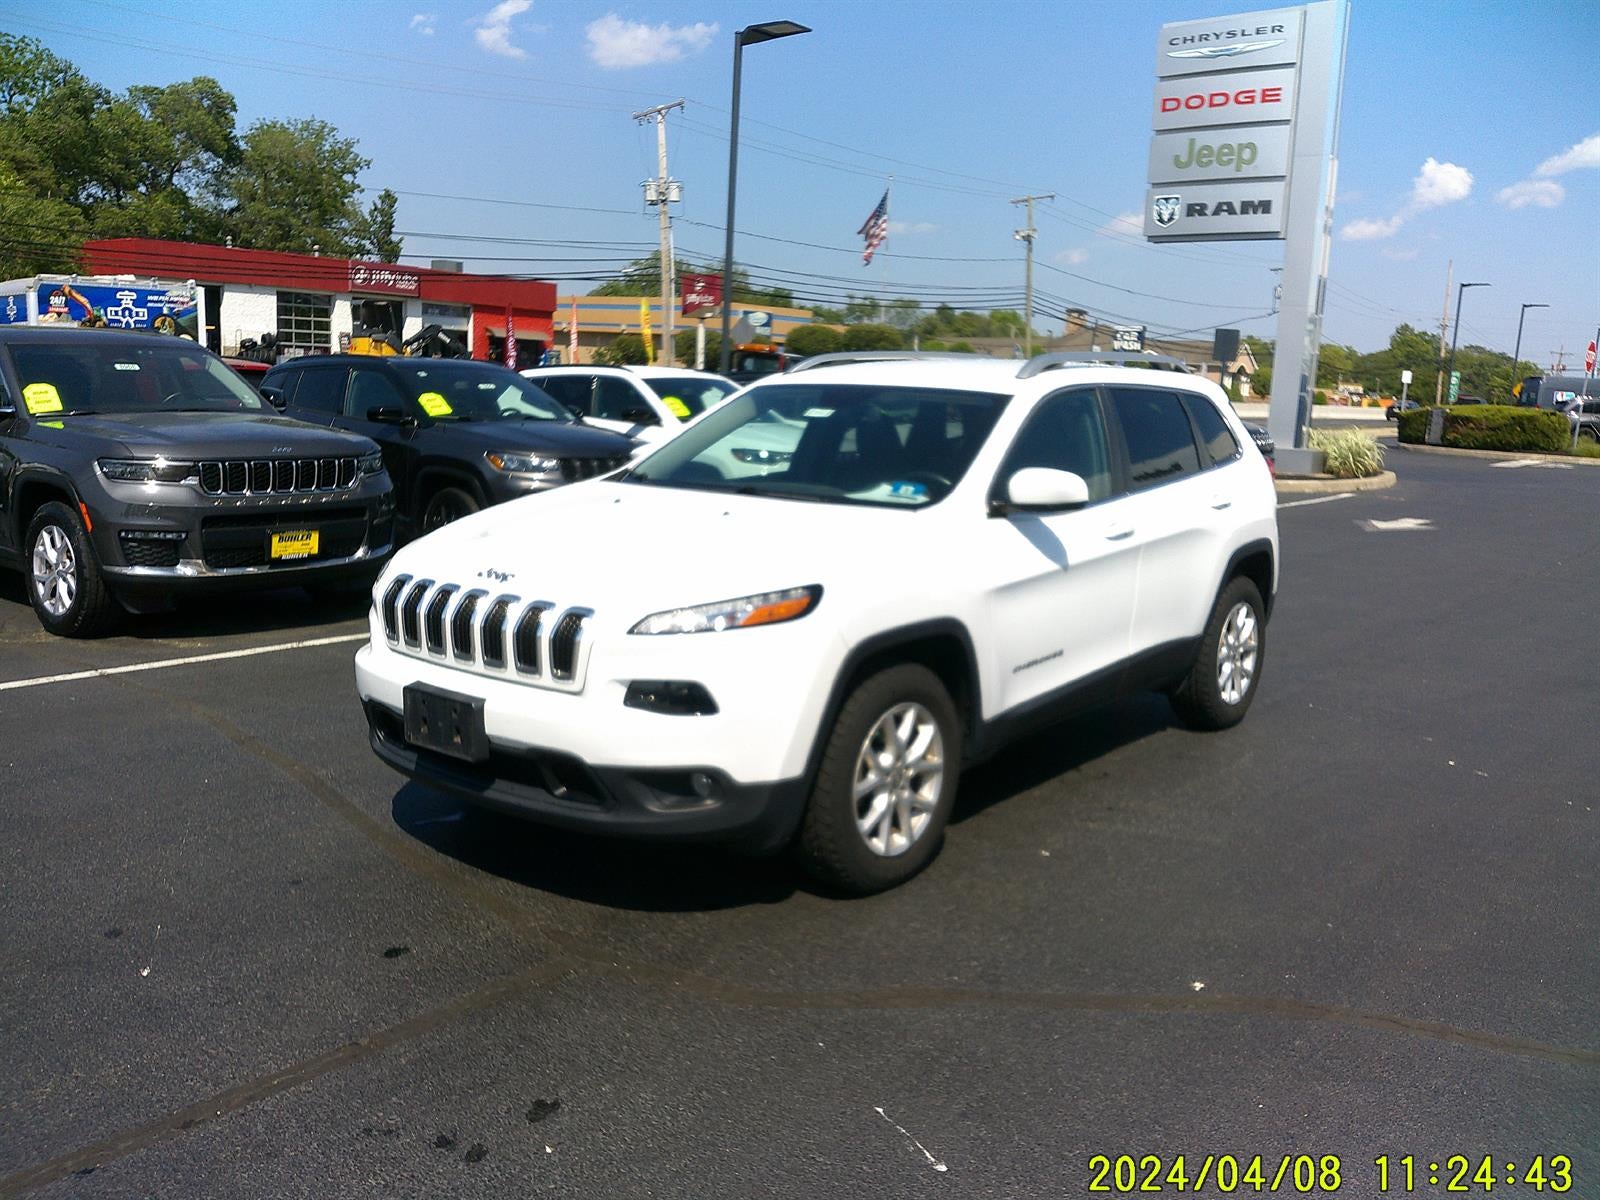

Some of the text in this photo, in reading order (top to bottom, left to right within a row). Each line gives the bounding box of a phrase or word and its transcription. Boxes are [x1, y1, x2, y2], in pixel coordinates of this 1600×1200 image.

[1168, 24, 1285, 46] CHRYSLER
[1160, 87, 1282, 112] DODGE
[1173, 138, 1258, 172] Jeep
[1186, 199, 1272, 217] RAM
[1113, 340, 1141, 351] WASH
